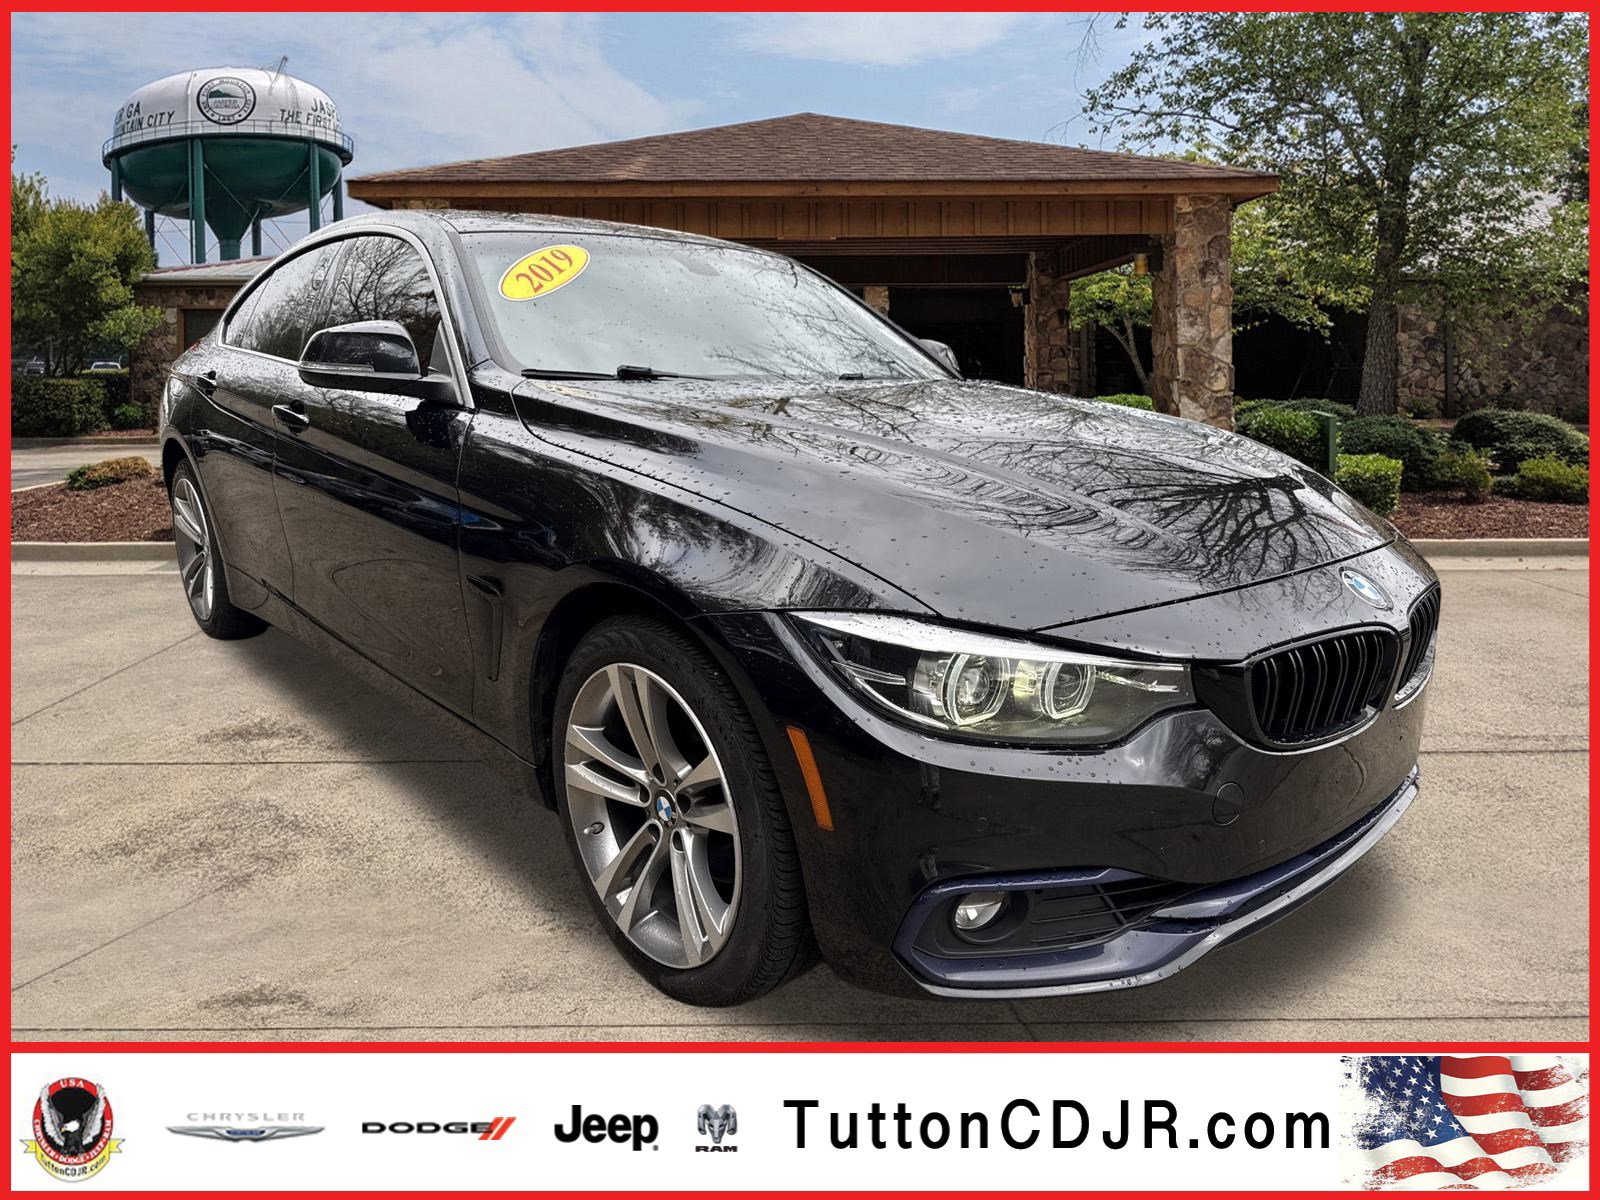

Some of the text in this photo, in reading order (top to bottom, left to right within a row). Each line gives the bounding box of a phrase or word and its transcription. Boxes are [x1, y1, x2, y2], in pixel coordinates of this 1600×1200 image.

[127, 100, 141, 119] GA
[147, 110, 175, 127] CITY
[280, 109, 302, 123] THE
[306, 112, 332, 129] FIRST
[516, 249, 573, 293] 2019
